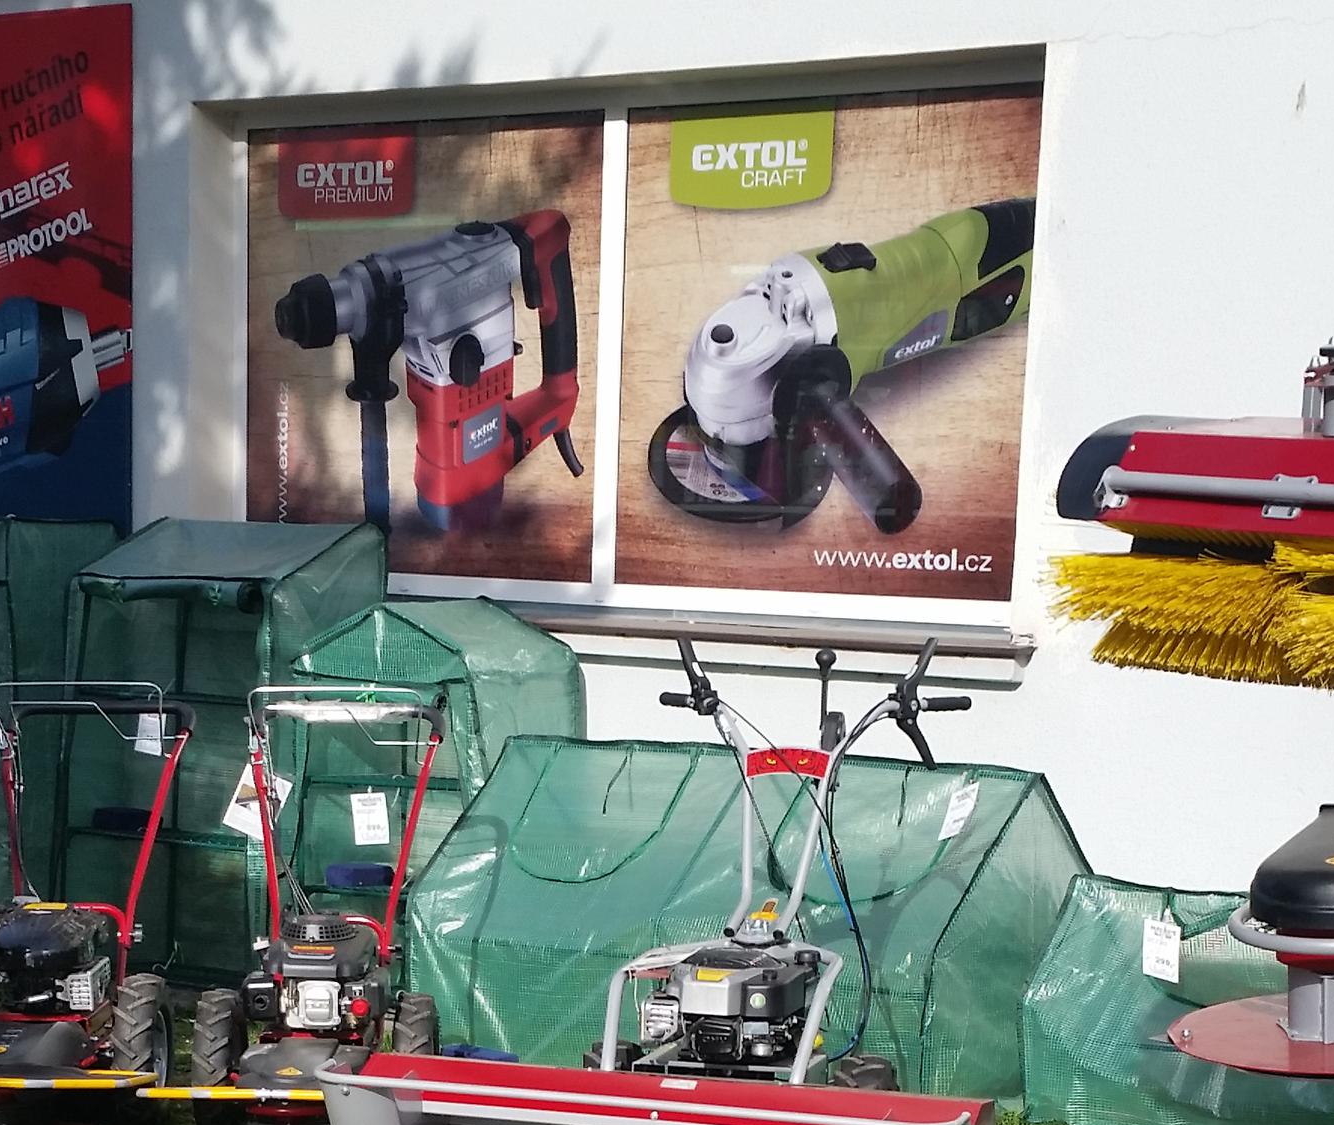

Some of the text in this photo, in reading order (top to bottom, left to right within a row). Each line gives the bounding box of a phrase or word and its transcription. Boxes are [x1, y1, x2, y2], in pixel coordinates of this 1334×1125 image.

[1, 51, 89, 110] ručního
[10, 85, 85, 145] nářadí
[314, 186, 393, 204] PREMIUM
[741, 168, 807, 188] CRAFT
[5, 208, 93, 263] PROTOOL
[814, 548, 993, 573] www.extol.cz
